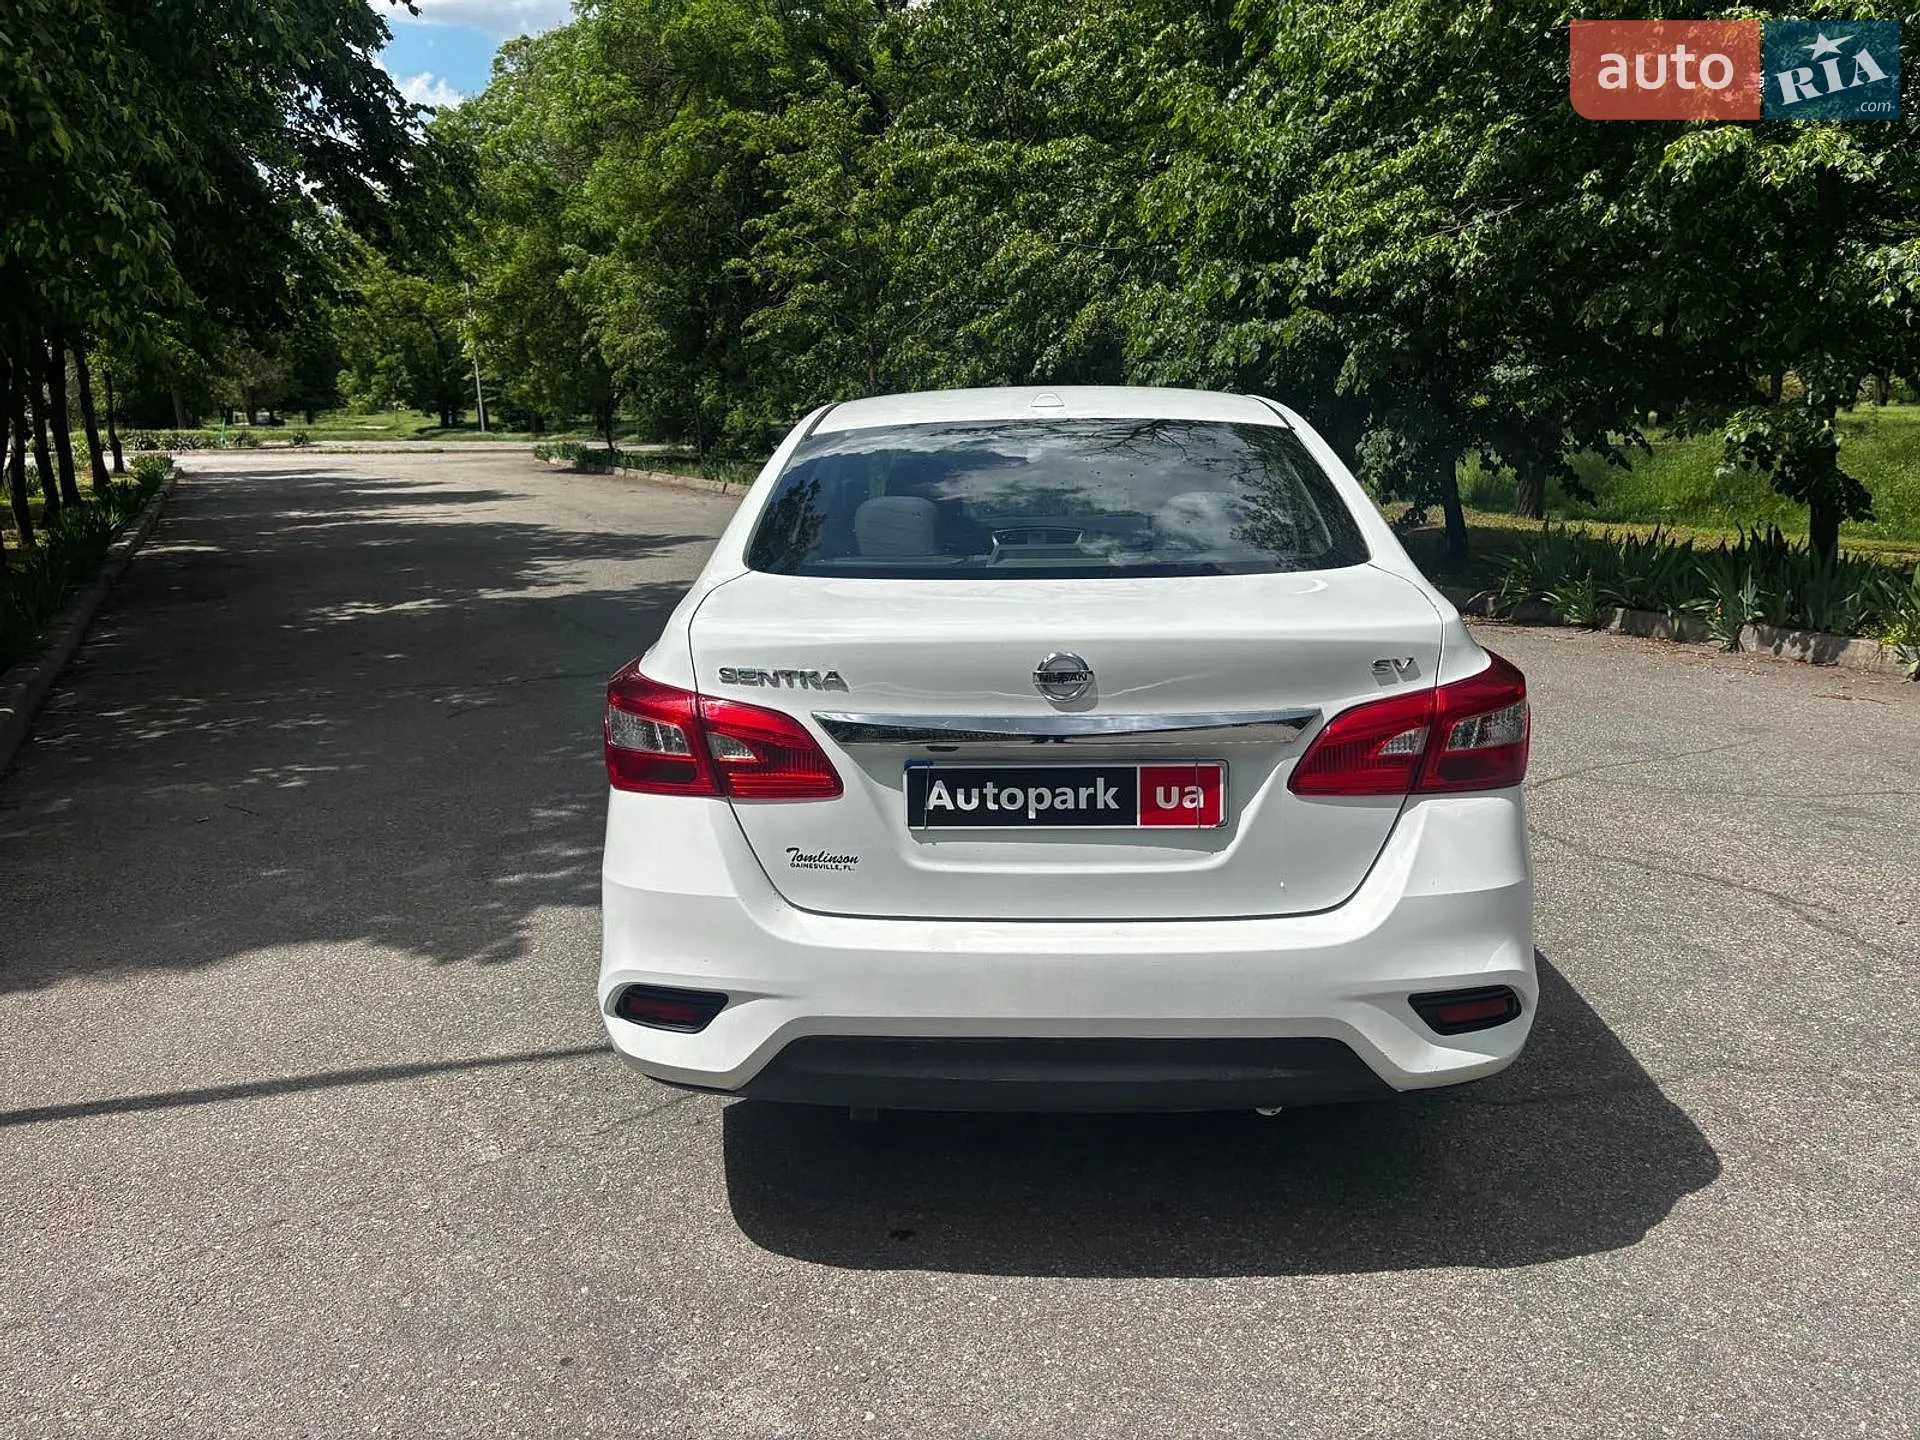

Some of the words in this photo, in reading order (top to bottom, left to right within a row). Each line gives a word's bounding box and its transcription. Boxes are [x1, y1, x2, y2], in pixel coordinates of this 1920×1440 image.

[1371, 657, 1414, 676] SV
[718, 667, 849, 692] SENTRA
[927, 777, 1120, 819] Autopark
[1155, 785, 1205, 809] ua
[786, 847, 859, 864] Tomlinson
